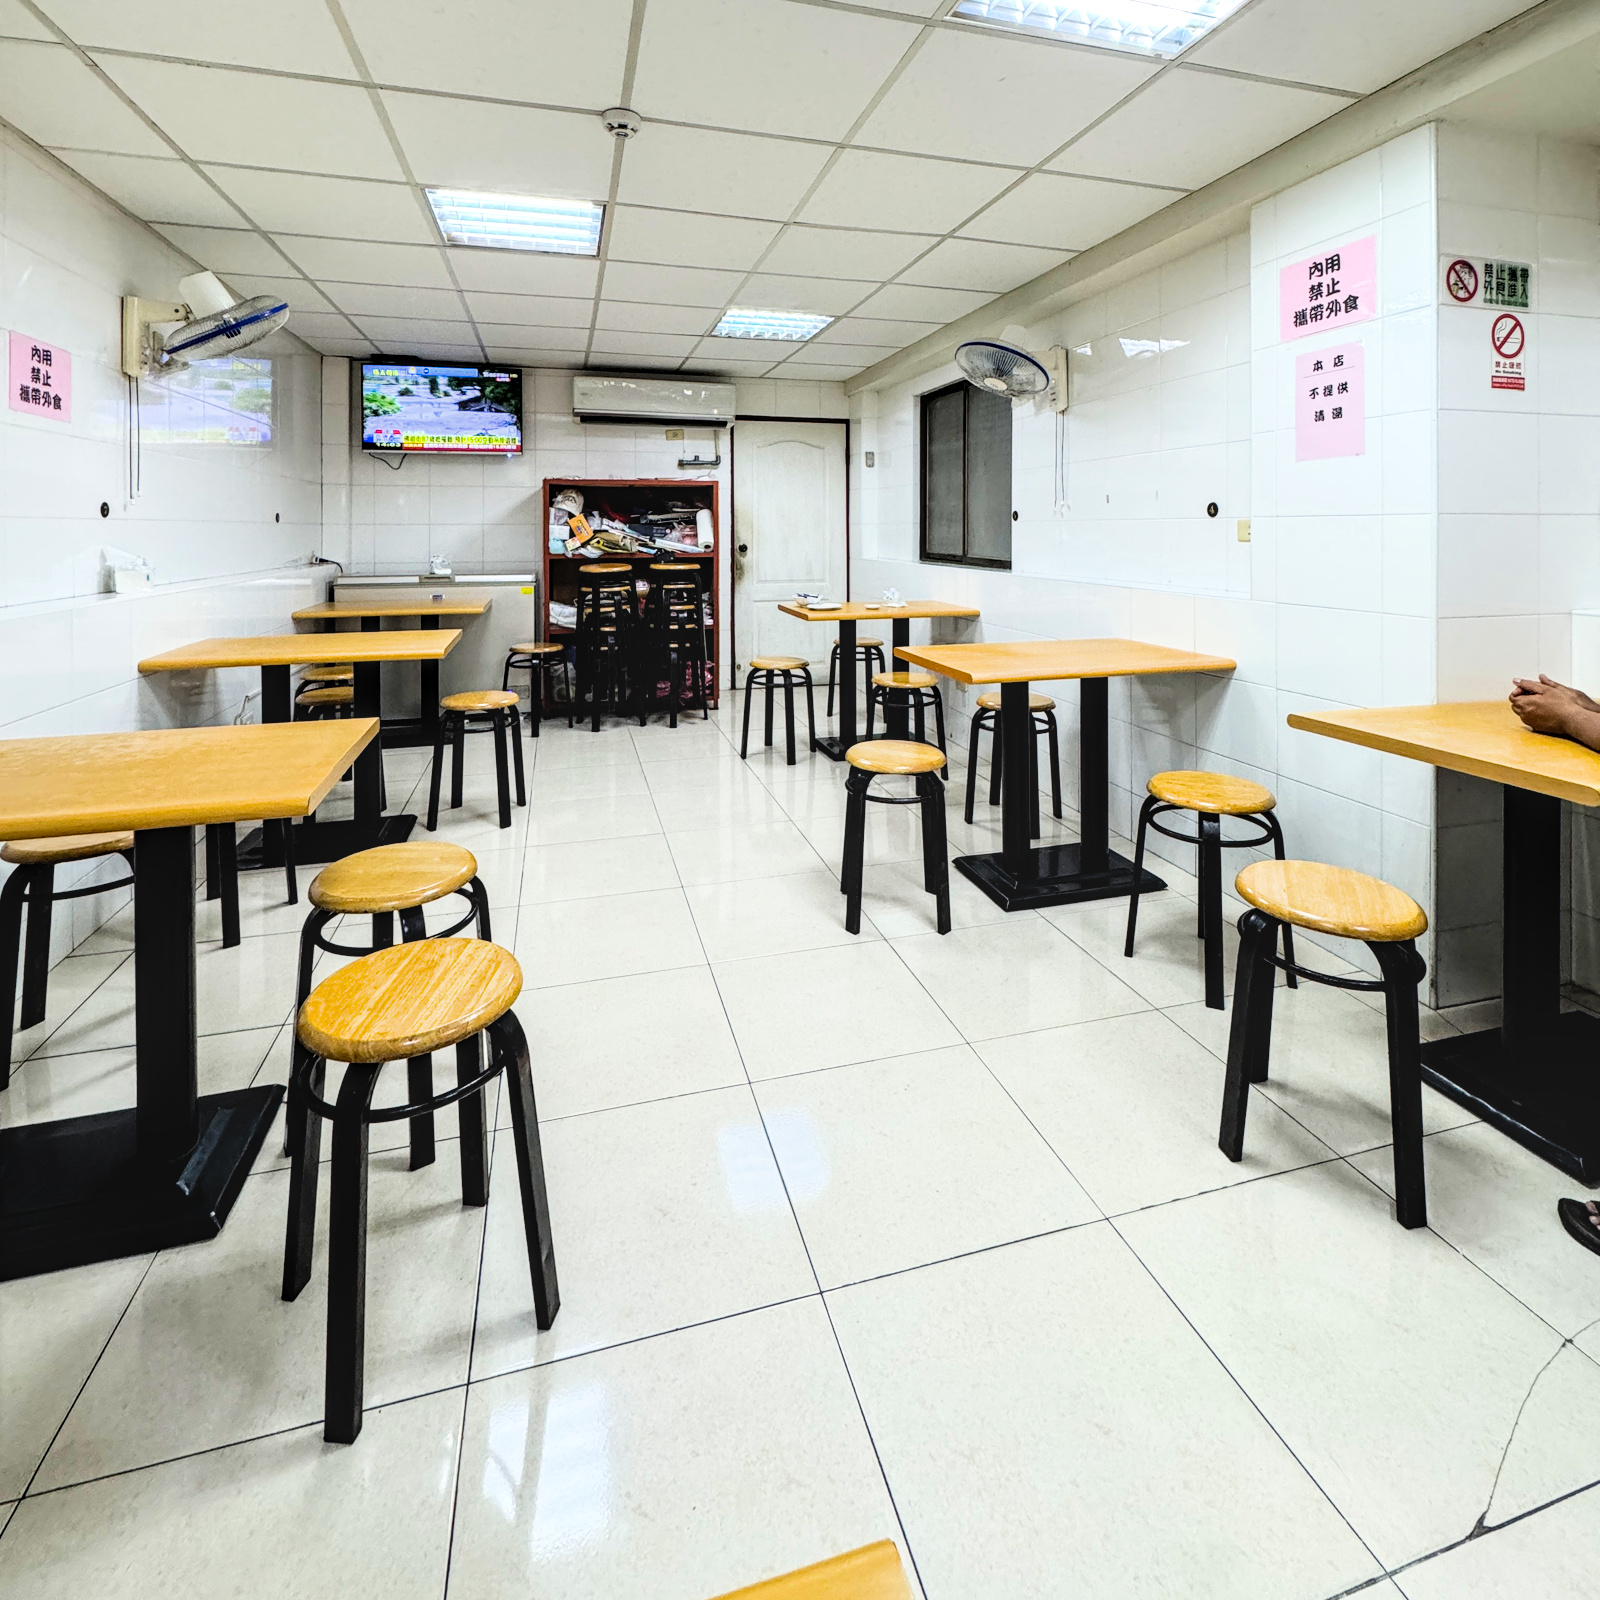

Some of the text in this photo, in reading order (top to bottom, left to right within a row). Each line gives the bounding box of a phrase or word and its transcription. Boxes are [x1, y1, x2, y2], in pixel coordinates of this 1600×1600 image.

[1308, 253, 1341, 280] 內用
[1484, 263, 1529, 283] 禁止攜帶
[1308, 277, 1341, 303] 禁止
[1484, 279, 1529, 300] 外食進入
[1293, 294, 1360, 328] 攜帶外食
[30, 345, 52, 367] 內用
[1312, 355, 1345, 372] 本店
[30, 366, 52, 387] 禁止
[19, 383, 62, 411] 攜帶外食
[1309, 382, 1349, 400] 不提供
